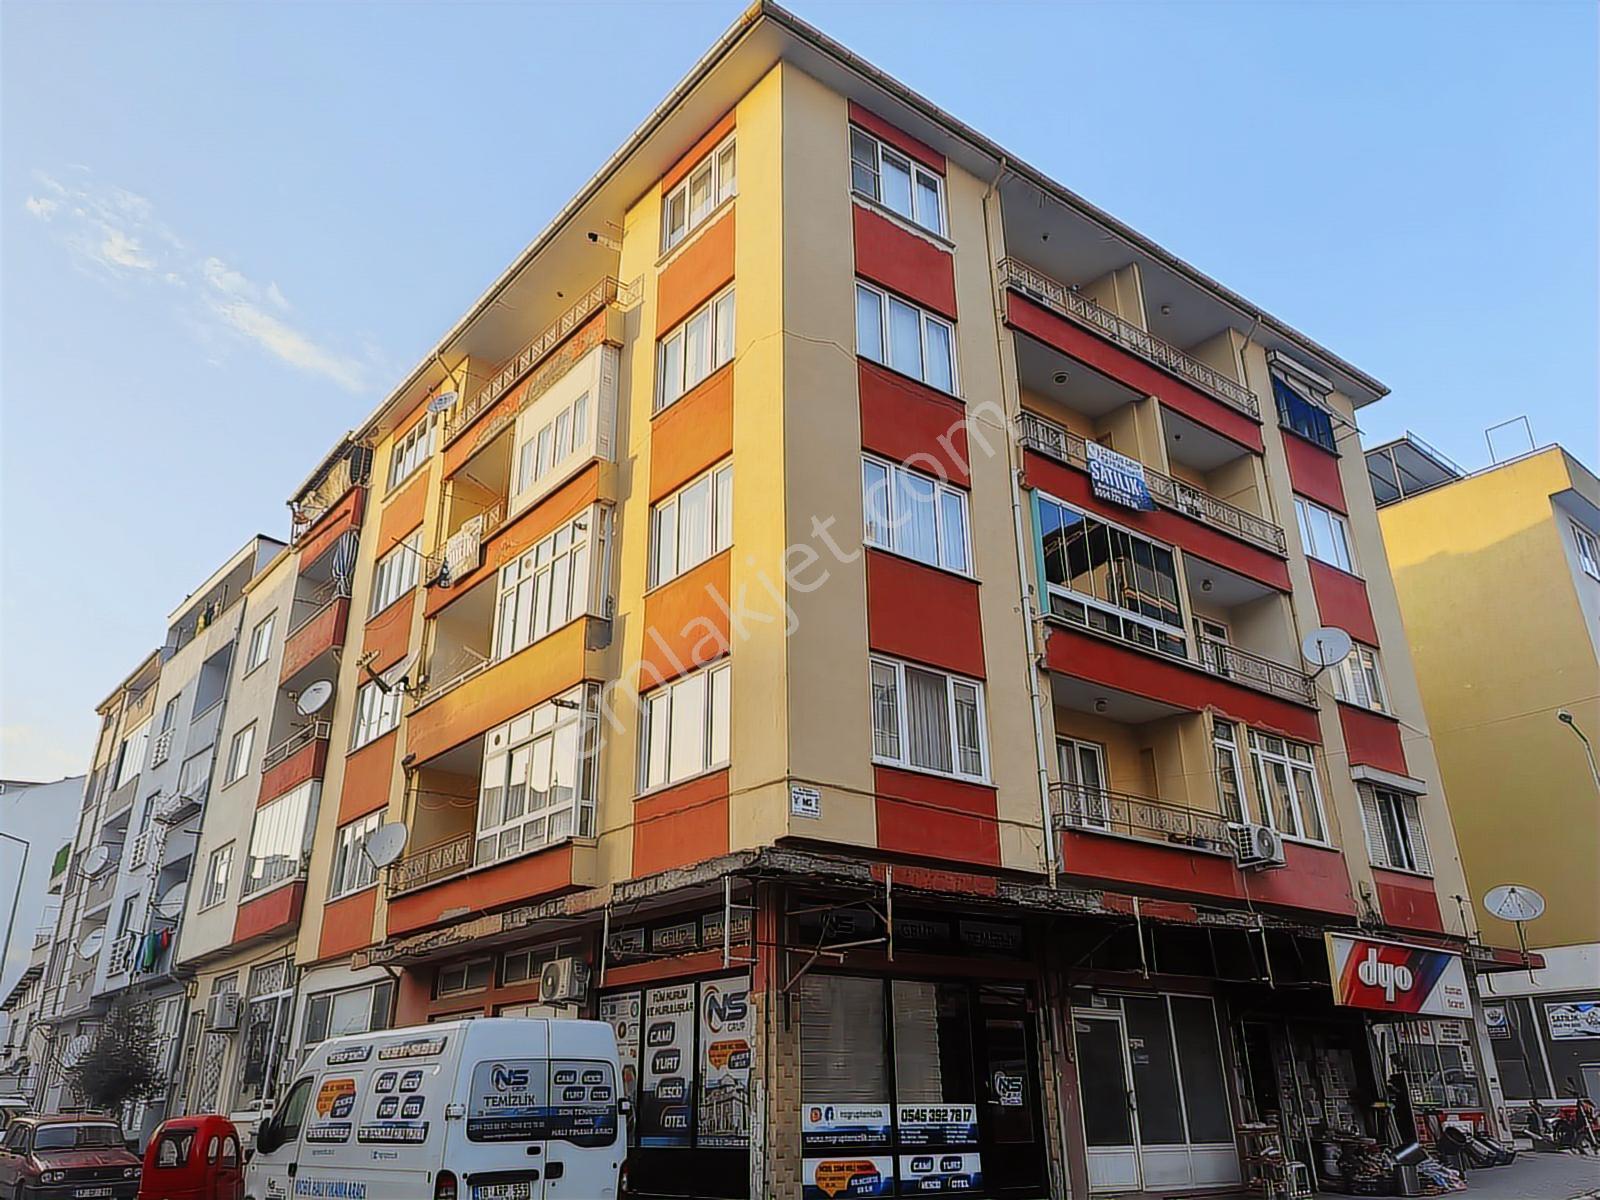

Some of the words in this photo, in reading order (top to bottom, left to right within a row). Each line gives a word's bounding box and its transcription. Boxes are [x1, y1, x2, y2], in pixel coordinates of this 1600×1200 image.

[1090, 461, 1140, 496] SATILIK
[660, 928, 687, 947] GRUP
[1358, 947, 1413, 1002] dyo
[709, 990, 749, 1023] NS
[650, 1025, 673, 1043] CAMİ
[655, 1057, 680, 1071] YURT
[495, 1069, 530, 1086] NS
[483, 1093, 536, 1107] TEMİZLİK
[664, 1115, 688, 1128] OTEL
[900, 1108, 927, 1123] 0545
[928, 1108, 948, 1123] 392
